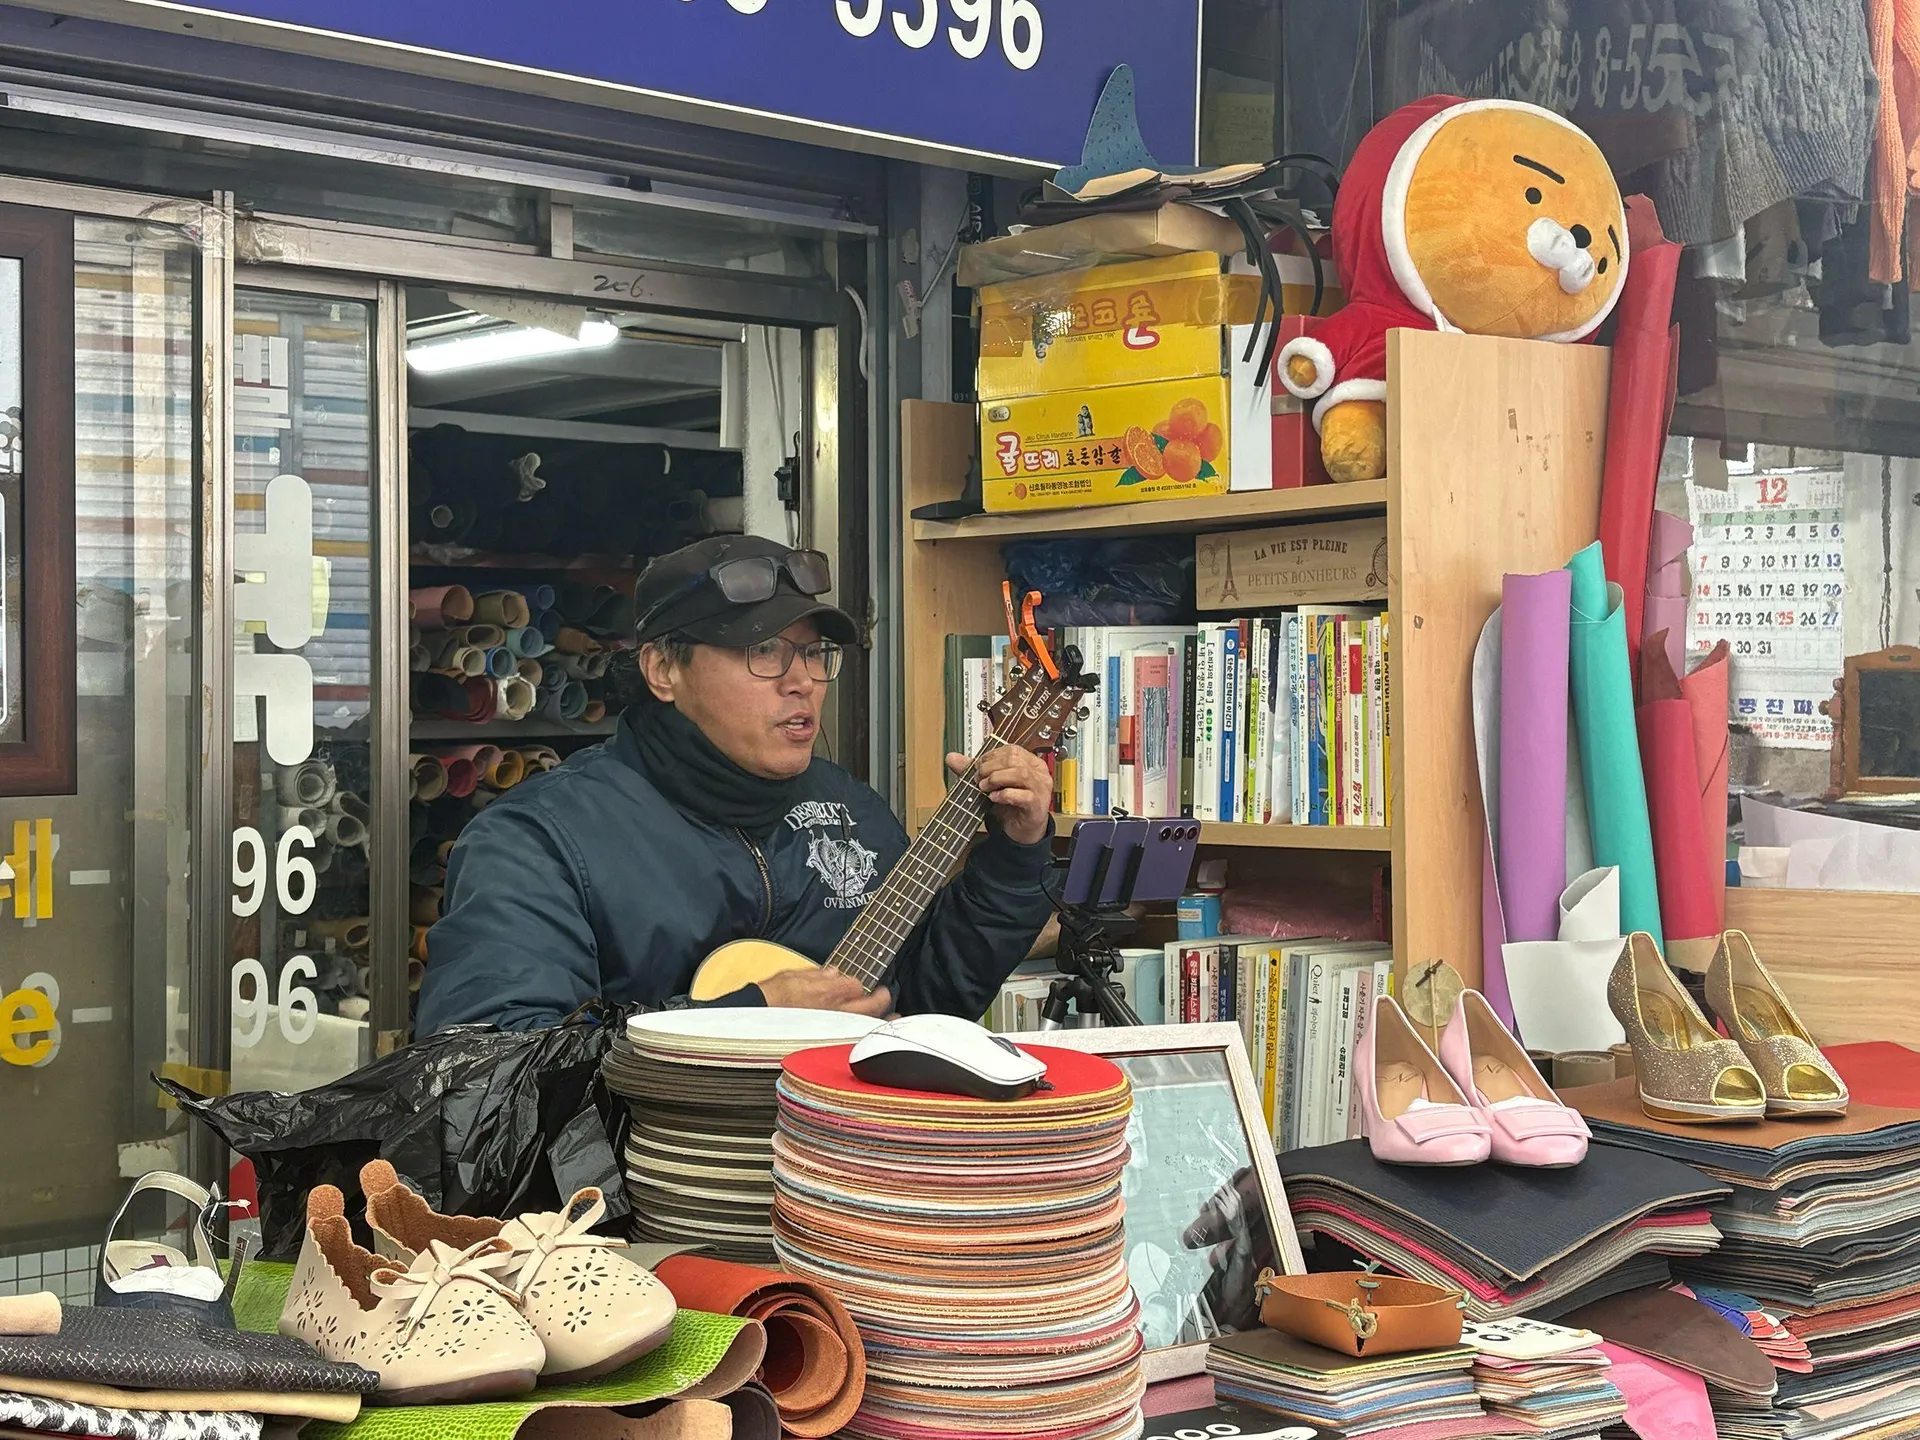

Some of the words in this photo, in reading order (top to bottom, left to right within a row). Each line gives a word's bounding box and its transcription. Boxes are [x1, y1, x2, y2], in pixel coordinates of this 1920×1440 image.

[1756, 477, 1788, 505] 12
[1724, 528, 1731, 540] 1
[1744, 527, 1754, 539] 2
[1765, 526, 1774, 539] 3
[1786, 525, 1796, 538] 4
[1809, 525, 1818, 538] 5
[1830, 524, 1840, 538] 6
[1254, 549, 1267, 561] LA
[1270, 541, 1287, 556] VIE
[1290, 538, 1309, 551] EST
[1312, 538, 1348, 554] PLEINE
[1699, 555, 1708, 568] 7
[1721, 555, 1730, 568] 8
[1742, 555, 1752, 568] 9
[1761, 555, 1775, 568] 10
[1782, 555, 1796, 568] 11
[1804, 554, 1820, 568] 12
[1826, 553, 1841, 567] 13
[1248, 571, 1289, 587] PETITS
[1291, 566, 1357, 584] BONHEURS
[1717, 584, 1731, 597] 15
[1738, 584, 1752, 597] 16
[1759, 584, 1773, 597] 17
[1779, 584, 1795, 597] 18
[1802, 583, 1818, 597] 19
[1823, 583, 1842, 597] 20
[1715, 612, 1731, 625] 22
[1735, 612, 1752, 625] 23
[1756, 611, 1772, 625] 24
[1777, 611, 1794, 625] 25
[1800, 612, 1817, 625] 26
[1822, 612, 1839, 625] 27
[1736, 641, 1751, 654] 30
[1757, 641, 1772, 654] 31
[1024, 688, 1052, 719] CRAFTER
[1190, 960, 1198, 976] 중국
[1311, 964, 1323, 995] Quiet
[1190, 978, 1199, 1015] 비즈니스의
